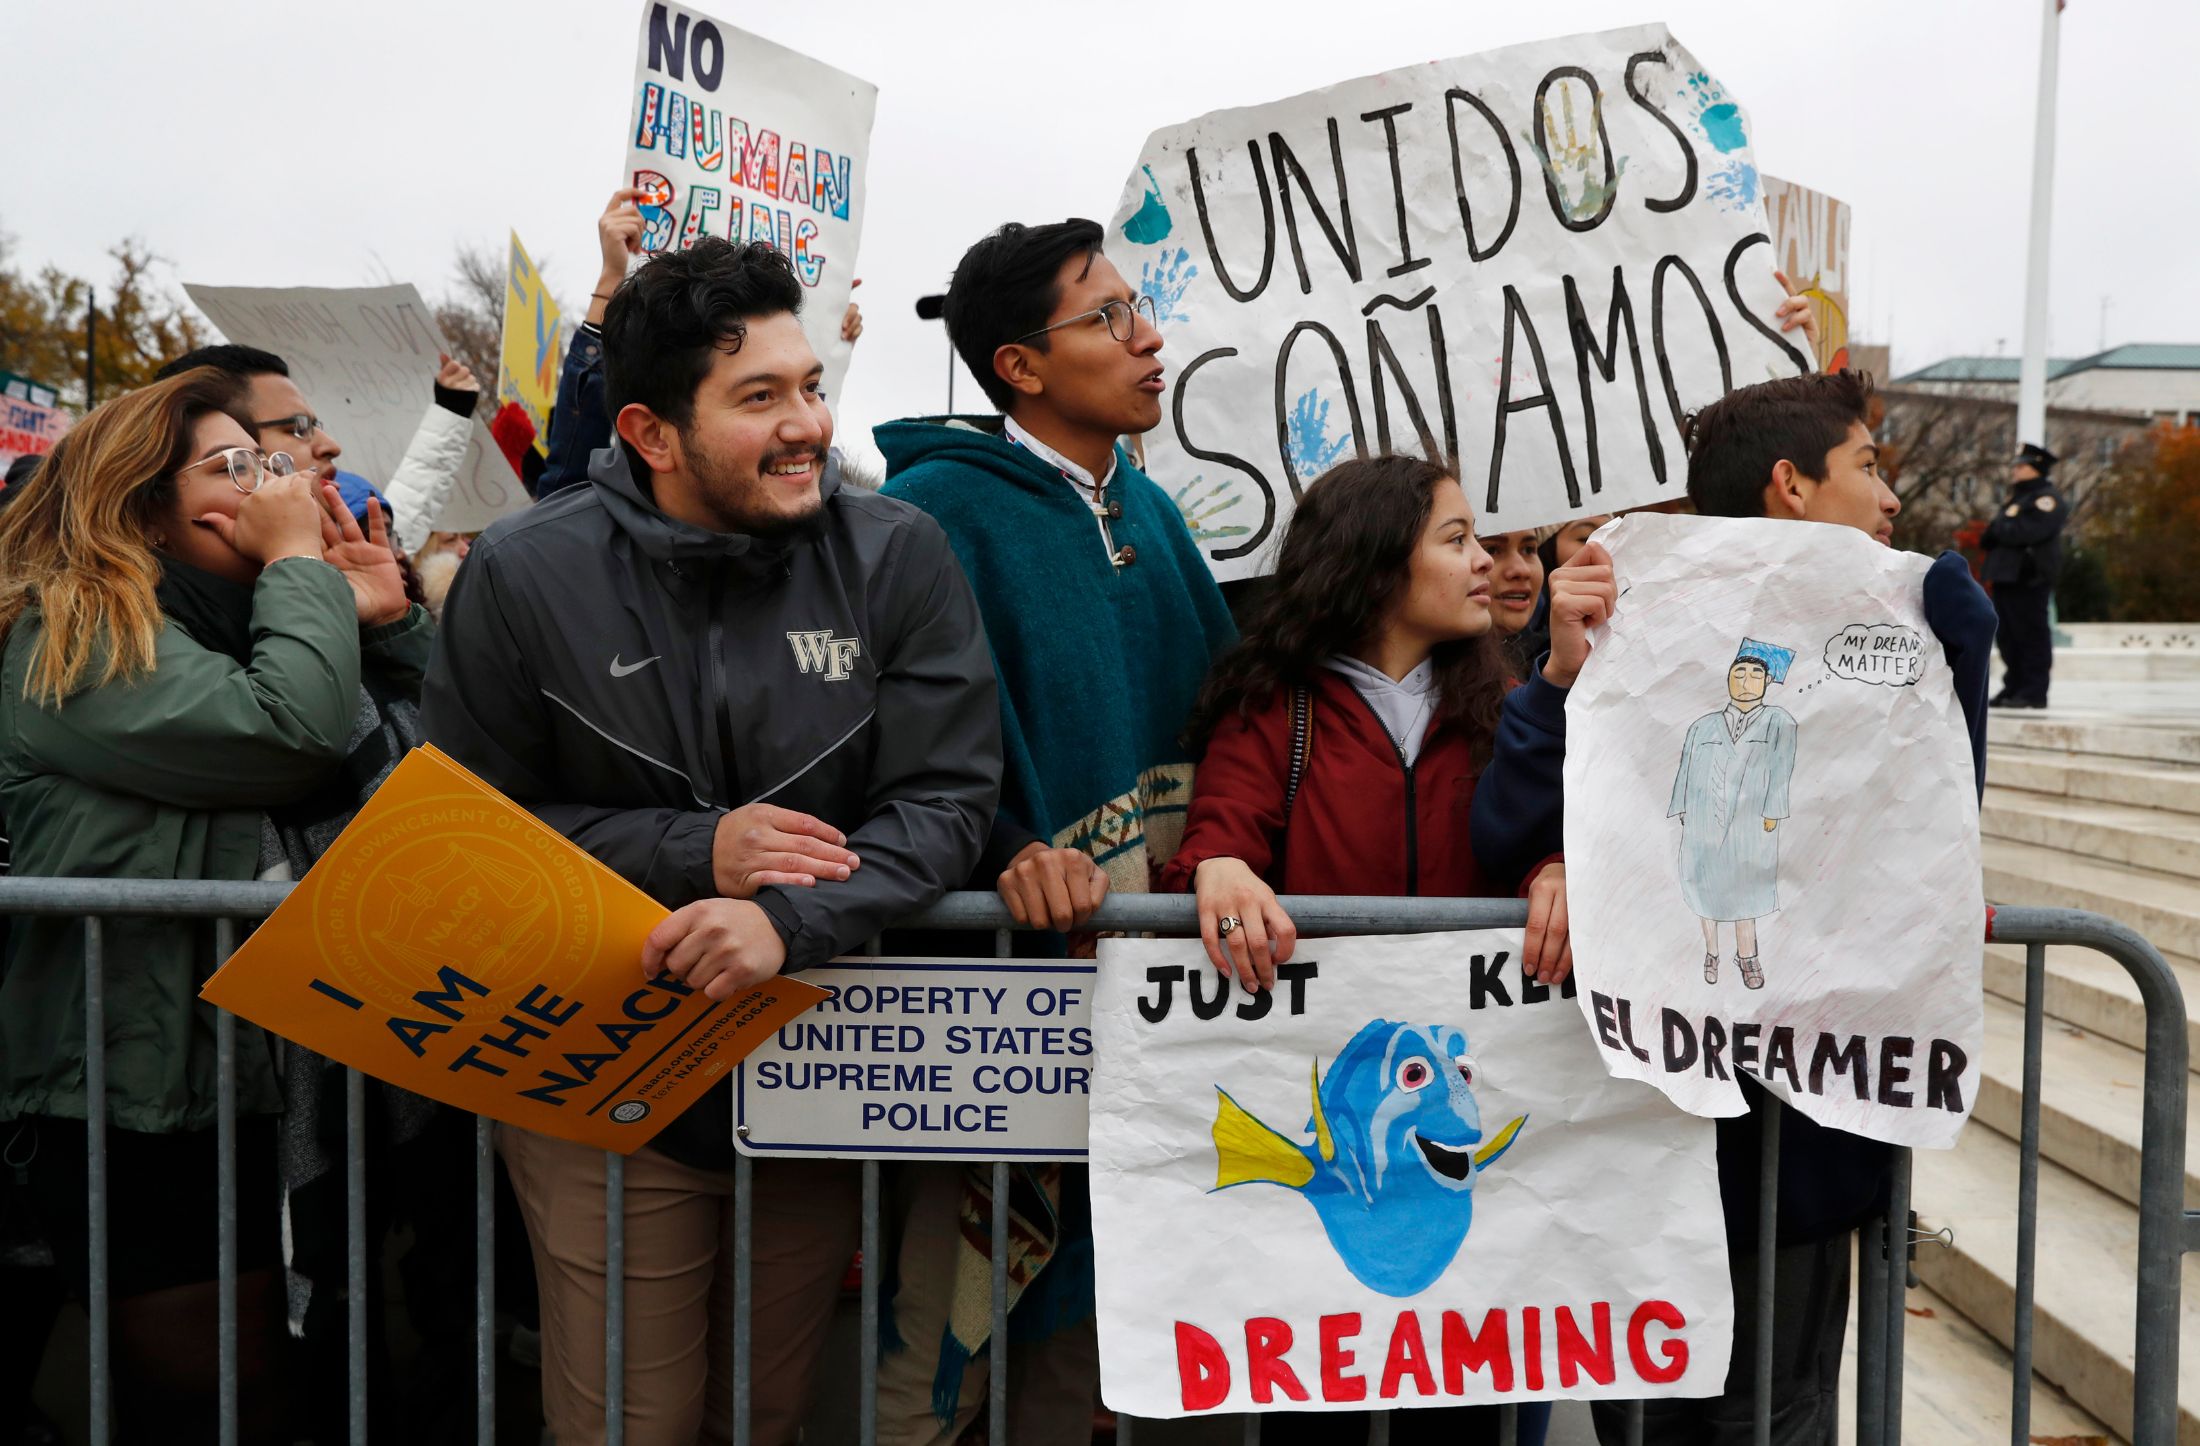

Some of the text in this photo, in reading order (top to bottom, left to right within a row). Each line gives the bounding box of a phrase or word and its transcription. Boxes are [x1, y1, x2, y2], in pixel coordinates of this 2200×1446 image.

[648, 3, 724, 92] NO
[635, 82, 851, 222] HUMAN
[1187, 51, 1699, 303] UNIDOS
[632, 170, 826, 287] BEING
[1172, 232, 1811, 559] SOÑAMOS
[786, 629, 860, 681] WF
[1838, 654, 1918, 676] MATTER
[1844, 636, 1867, 650] MY
[329, 909, 345, 940] FOR
[337, 869, 357, 901] THE
[352, 808, 492, 871] ADVANCEMENT
[496, 814, 522, 835] OF
[524, 828, 584, 899] COLORED
[564, 902, 589, 963] PEOPLE
[424, 886, 484, 947] NAACP
[308, 978, 364, 1011] I
[386, 965, 491, 1058] AM
[447, 983, 584, 1077] THE
[816, 984, 1082, 1016] ROPERTY OF
[1137, 961, 1319, 1023] JUST
[637, 991, 763, 1096] naacp.org/membership
[651, 1081, 679, 1100] text
[677, 1041, 720, 1080] NAACP
[721, 1028, 737, 1042] to
[735, 996, 778, 1029] 40649
[756, 1061, 953, 1093] SUPREME
[972, 1065, 1094, 1095] COUR
[778, 1023, 1094, 1056] UNITED STATES
[1591, 989, 1968, 1113] EL DREAMER
[862, 1102, 1008, 1133] POLICE
[1174, 1299, 1690, 1412] DREAMING
